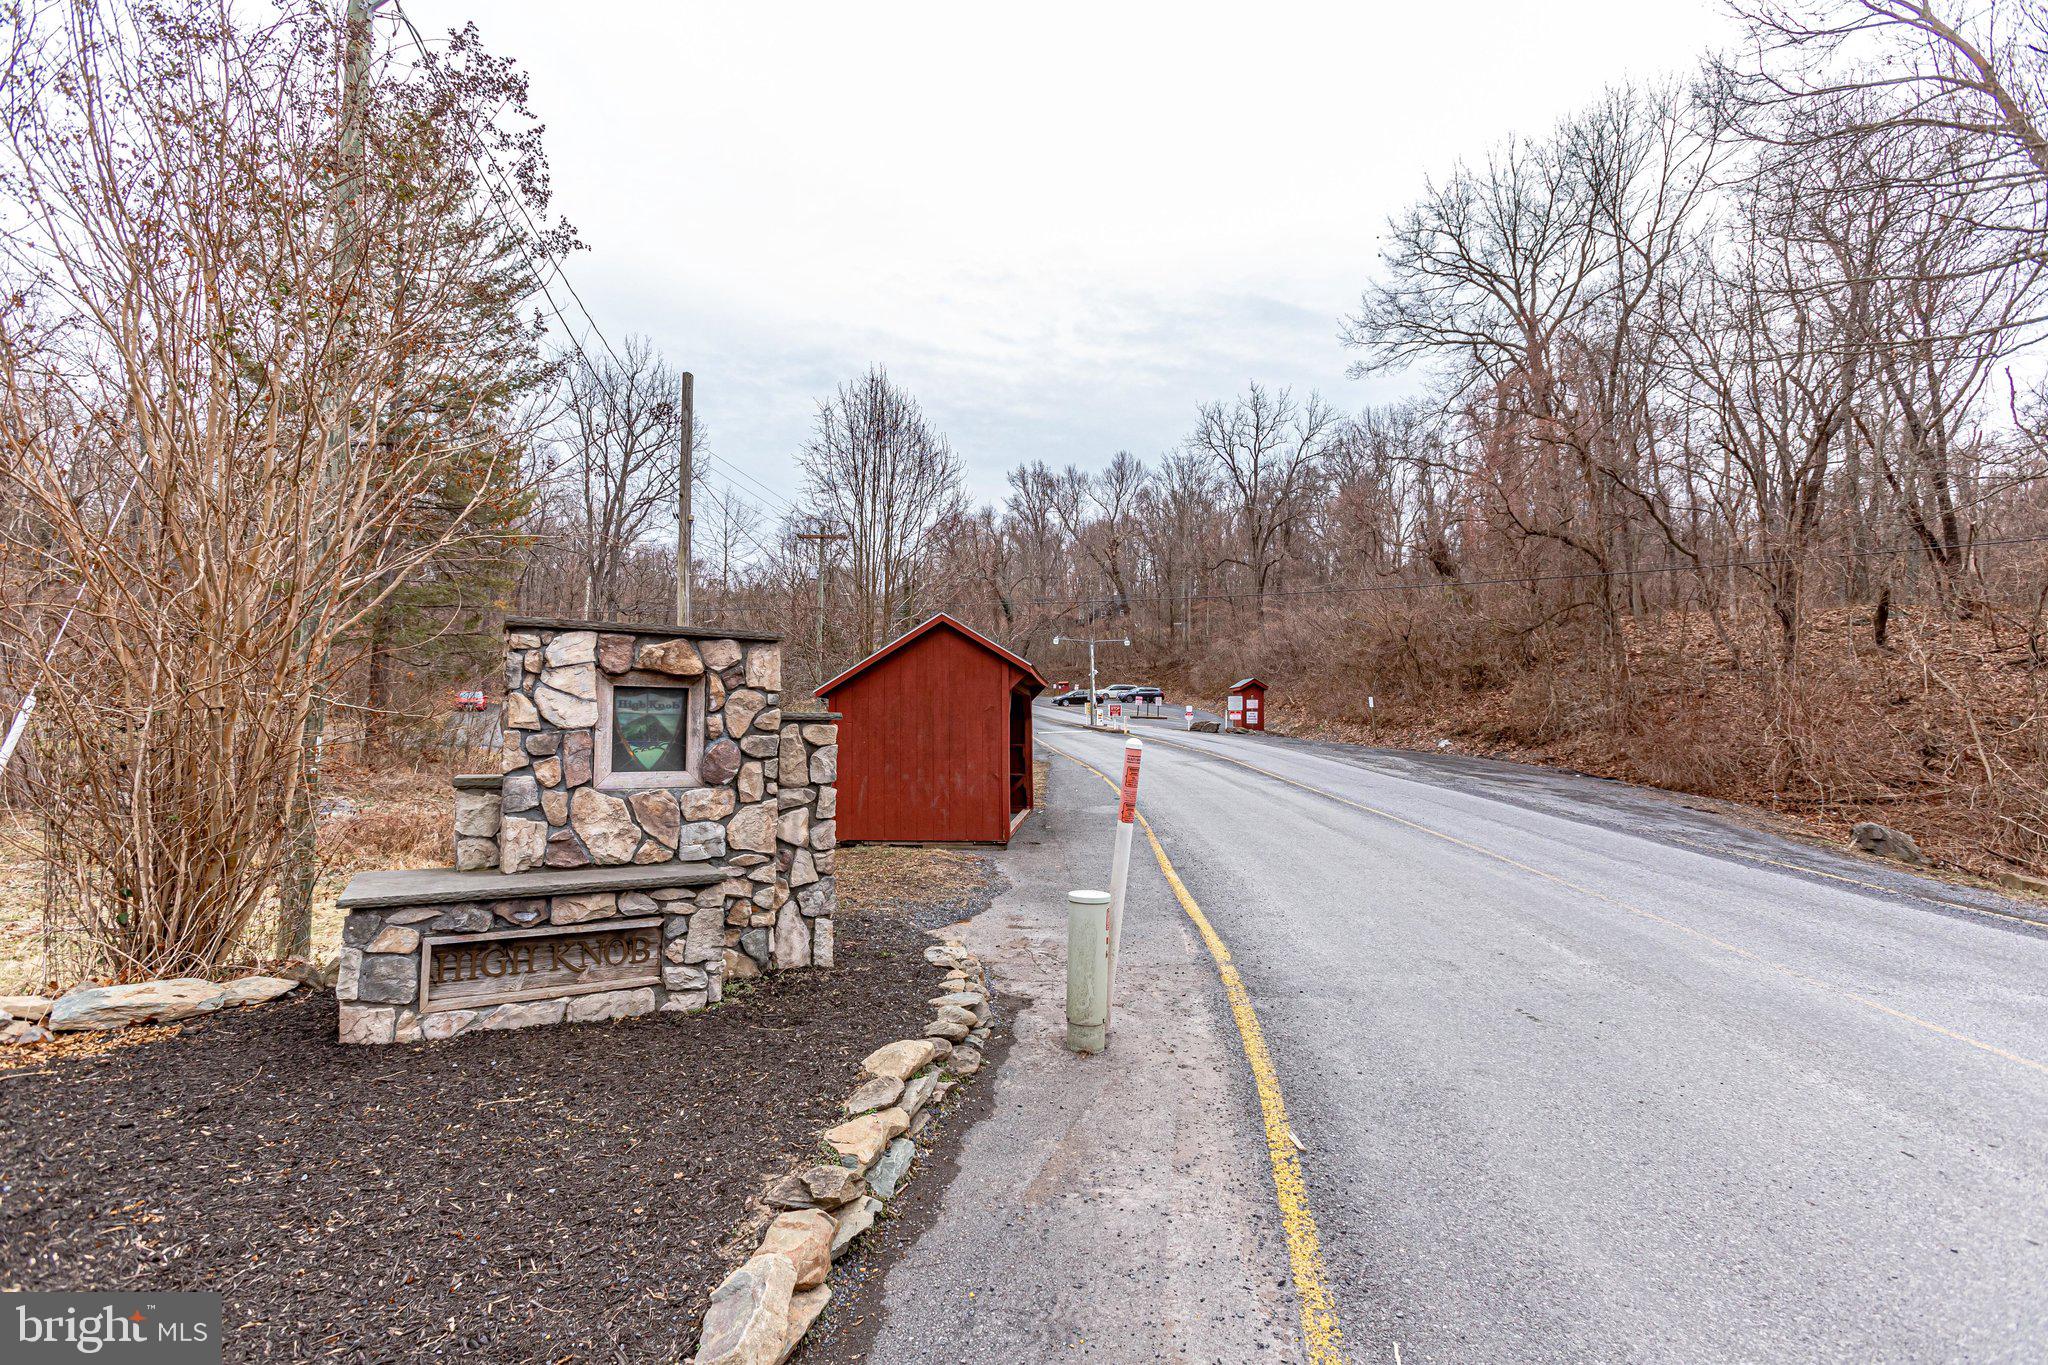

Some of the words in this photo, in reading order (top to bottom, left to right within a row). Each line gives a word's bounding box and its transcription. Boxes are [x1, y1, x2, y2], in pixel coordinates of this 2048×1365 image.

[618, 699, 647, 711] High
[648, 700, 680, 710] Knob
[435, 943, 538, 983] HIGH
[549, 936, 652, 973] KNOB
